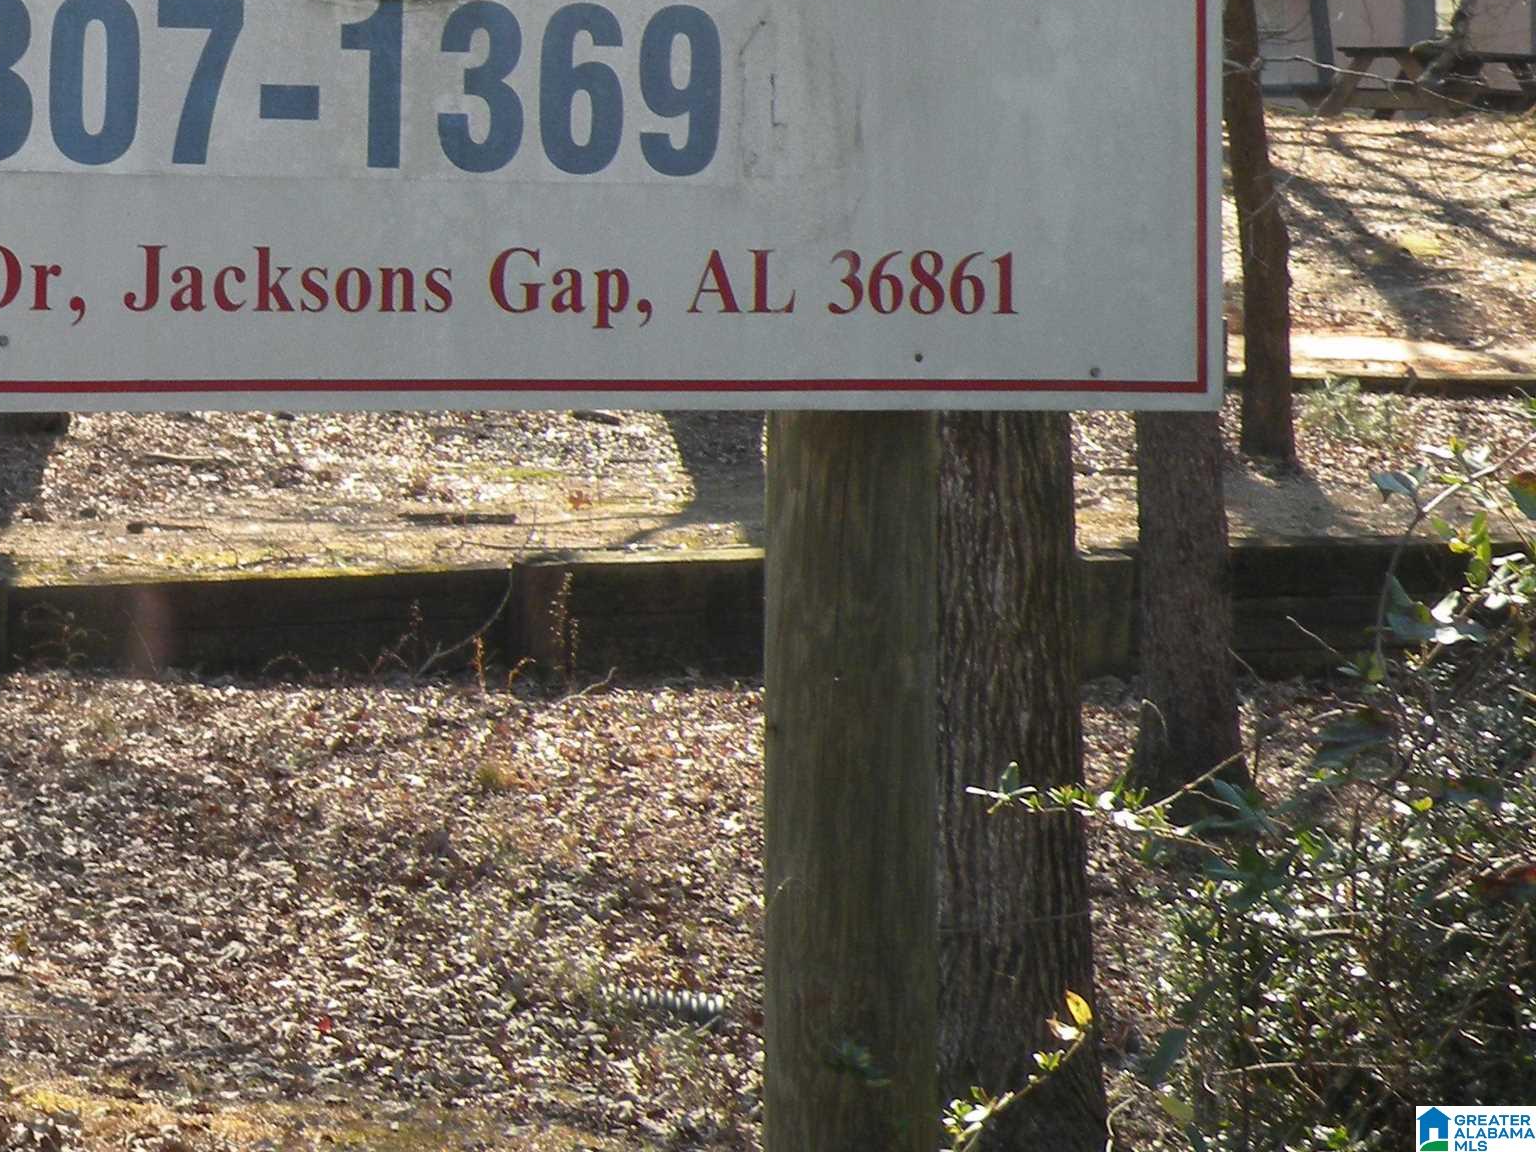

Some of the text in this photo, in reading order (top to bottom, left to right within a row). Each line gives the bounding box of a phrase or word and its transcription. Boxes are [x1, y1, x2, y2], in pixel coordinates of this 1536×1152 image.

[123, 244, 453, 314] Jacksons
[490, 247, 652, 329] Gap,
[686, 248, 796, 314] AL
[827, 249, 1020, 316] 36861
